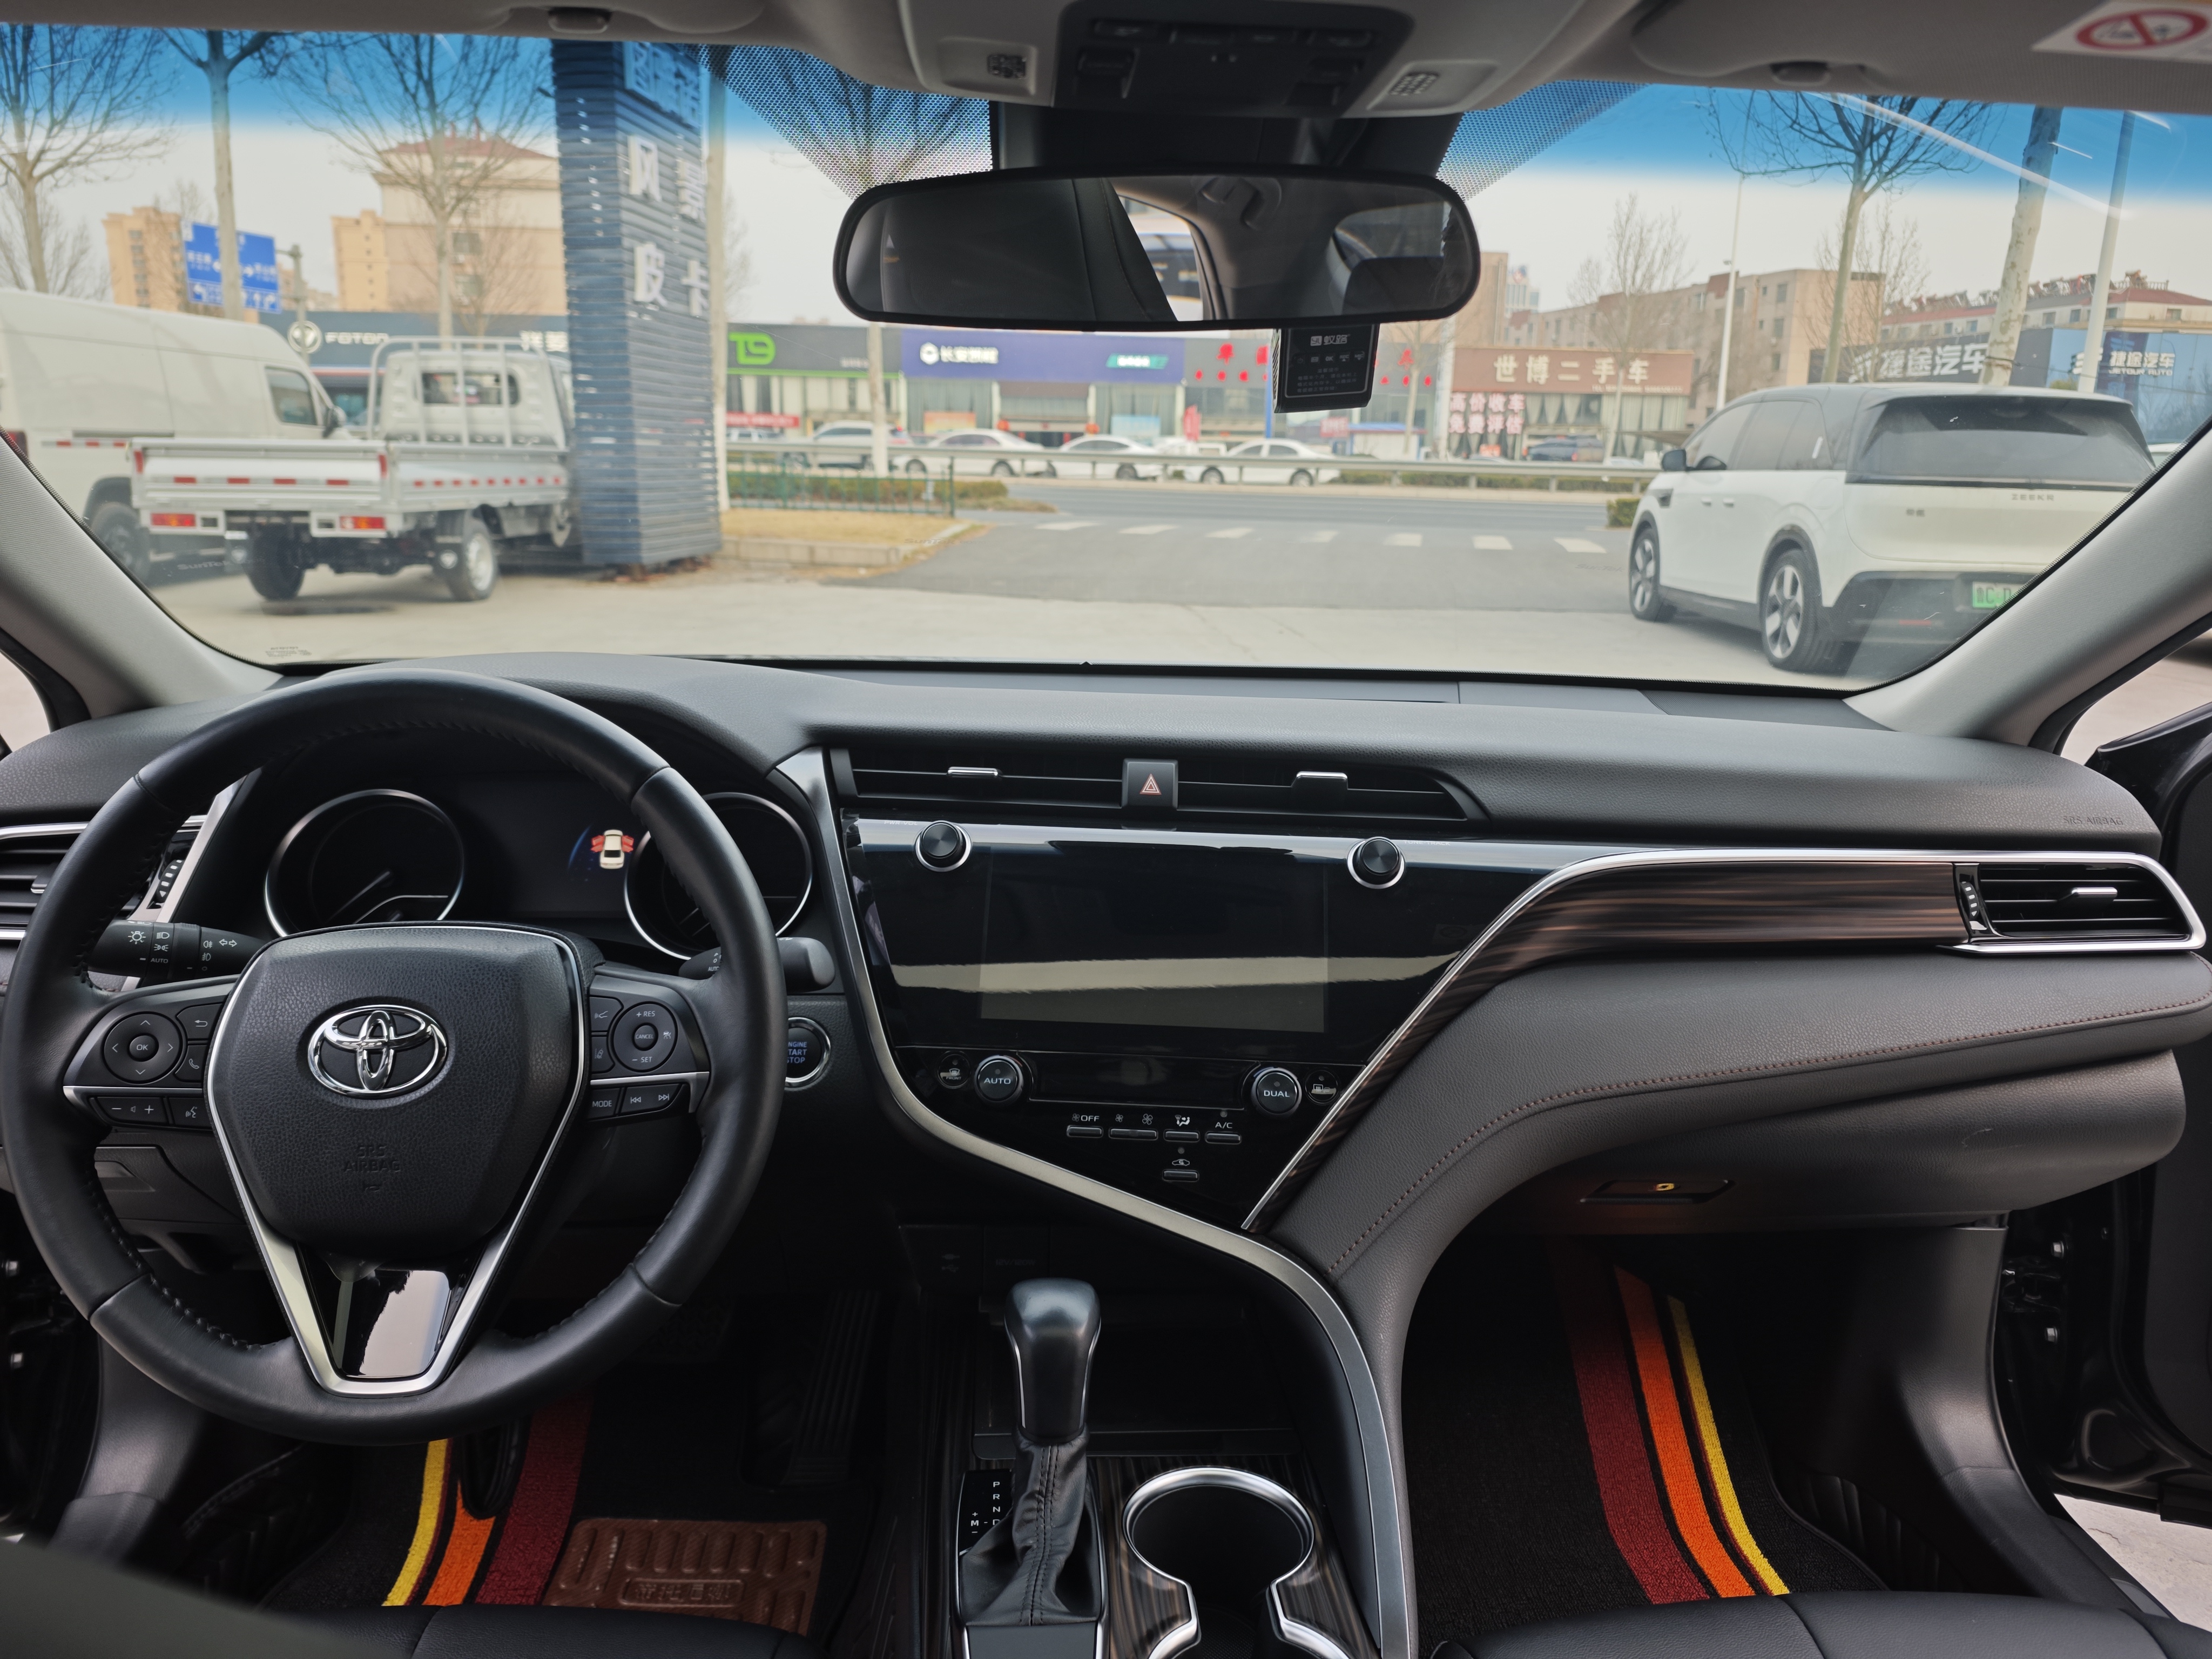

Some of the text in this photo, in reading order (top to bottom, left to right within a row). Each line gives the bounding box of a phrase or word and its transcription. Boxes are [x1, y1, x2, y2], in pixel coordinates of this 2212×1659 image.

[628, 136, 706, 223] 风景
[634, 242, 708, 316] 皮卡
[2110, 350, 2175, 368] 捷途汽车
[1493, 354, 1649, 385] 世博二手车
[1451, 393, 1526, 413] 高价收车
[1448, 413, 1524, 434] 免费评估
[2063, 816, 2123, 826] SRS AIRBAG
[357, 1145, 387, 1158] SRS
[343, 1161, 401, 1172] AIRBAG
